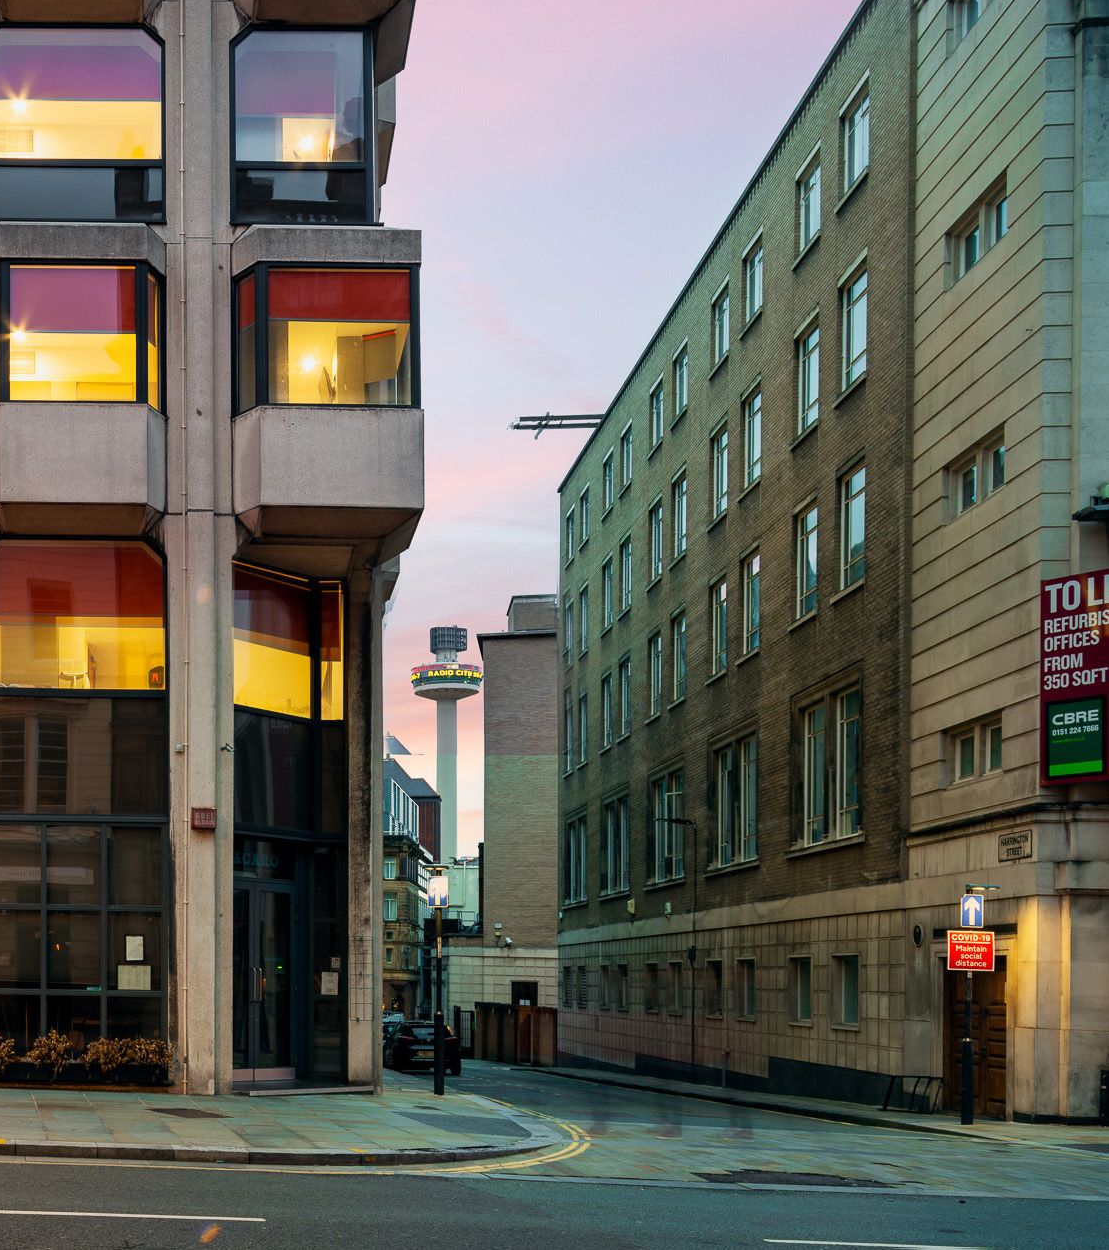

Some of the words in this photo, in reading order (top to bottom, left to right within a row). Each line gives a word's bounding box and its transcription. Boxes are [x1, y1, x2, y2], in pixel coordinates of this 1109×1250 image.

[1045, 580, 1081, 613] TO
[1044, 630, 1100, 652] OFFICES
[1044, 653, 1083, 672] FROM
[427, 669, 454, 678] RADIO
[1043, 672, 1070, 690] 350
[1072, 667, 1109, 687] SQFT
[1052, 709, 1099, 725] CBRE
[1052, 728, 1068, 737] 0151
[1069, 726, 1082, 735] 224
[1082, 724, 1099, 733] 7666
[1006, 846, 1023, 857] STREET
[951, 933, 991, 942] COVID-19
[955, 944, 988, 953] Maintain
[960, 952, 983, 960] social
[955, 959, 987, 968] distance
